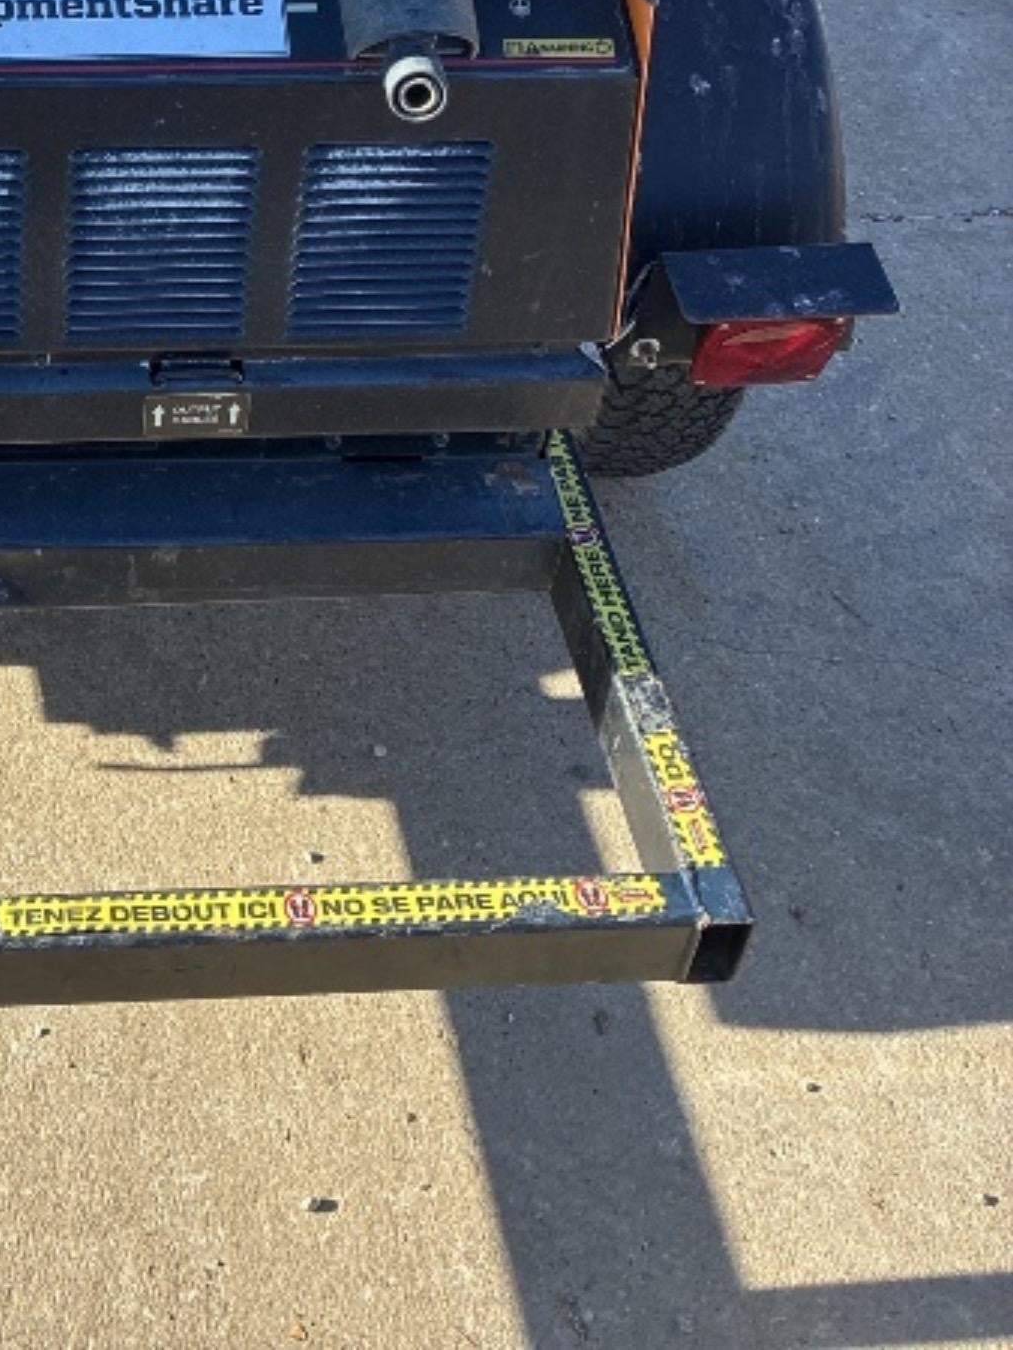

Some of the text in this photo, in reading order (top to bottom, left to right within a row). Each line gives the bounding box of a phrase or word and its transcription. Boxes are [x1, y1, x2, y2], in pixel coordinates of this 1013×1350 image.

[607, 611, 643, 672] TAND
[6, 906, 103, 927] TENEZ
[109, 902, 231, 923] DEBOUT
[238, 900, 276, 919] ICI
[321, 898, 366, 917] NO
[371, 896, 409, 916] SE
[416, 892, 495, 913] PARE
